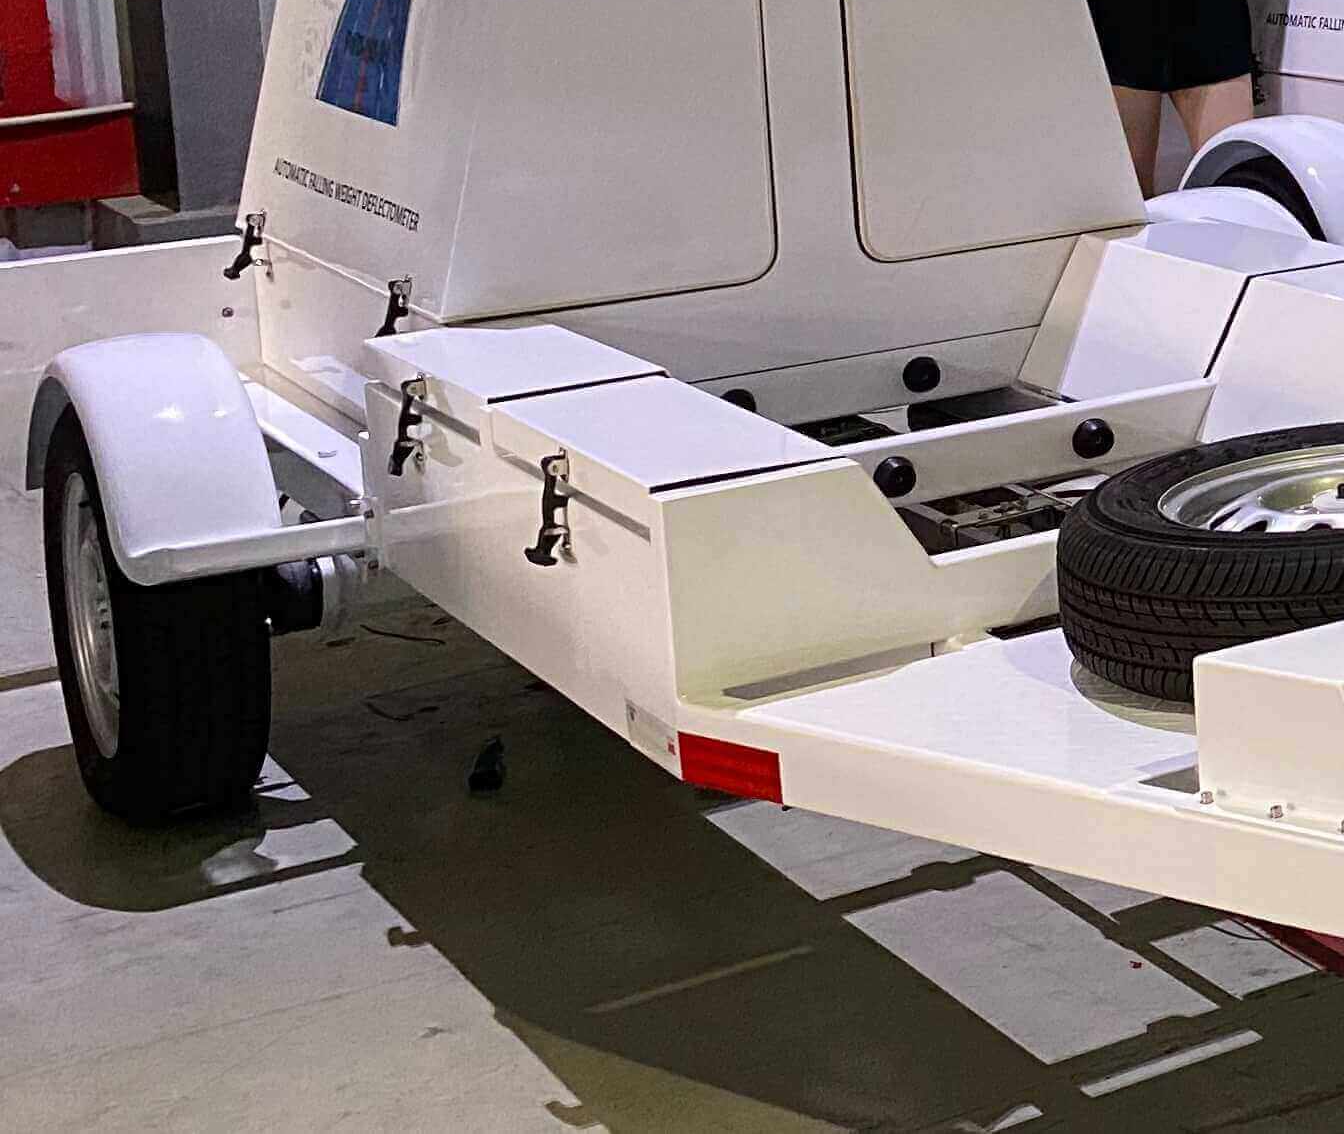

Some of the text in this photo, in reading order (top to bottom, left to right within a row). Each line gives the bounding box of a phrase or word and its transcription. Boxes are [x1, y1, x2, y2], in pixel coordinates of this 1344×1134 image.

[1266, 13, 1316, 29] AUTOMATIC
[274, 157, 420, 232] AUTOMATIC FALLING WEIGHT DEFLECTOMETER
